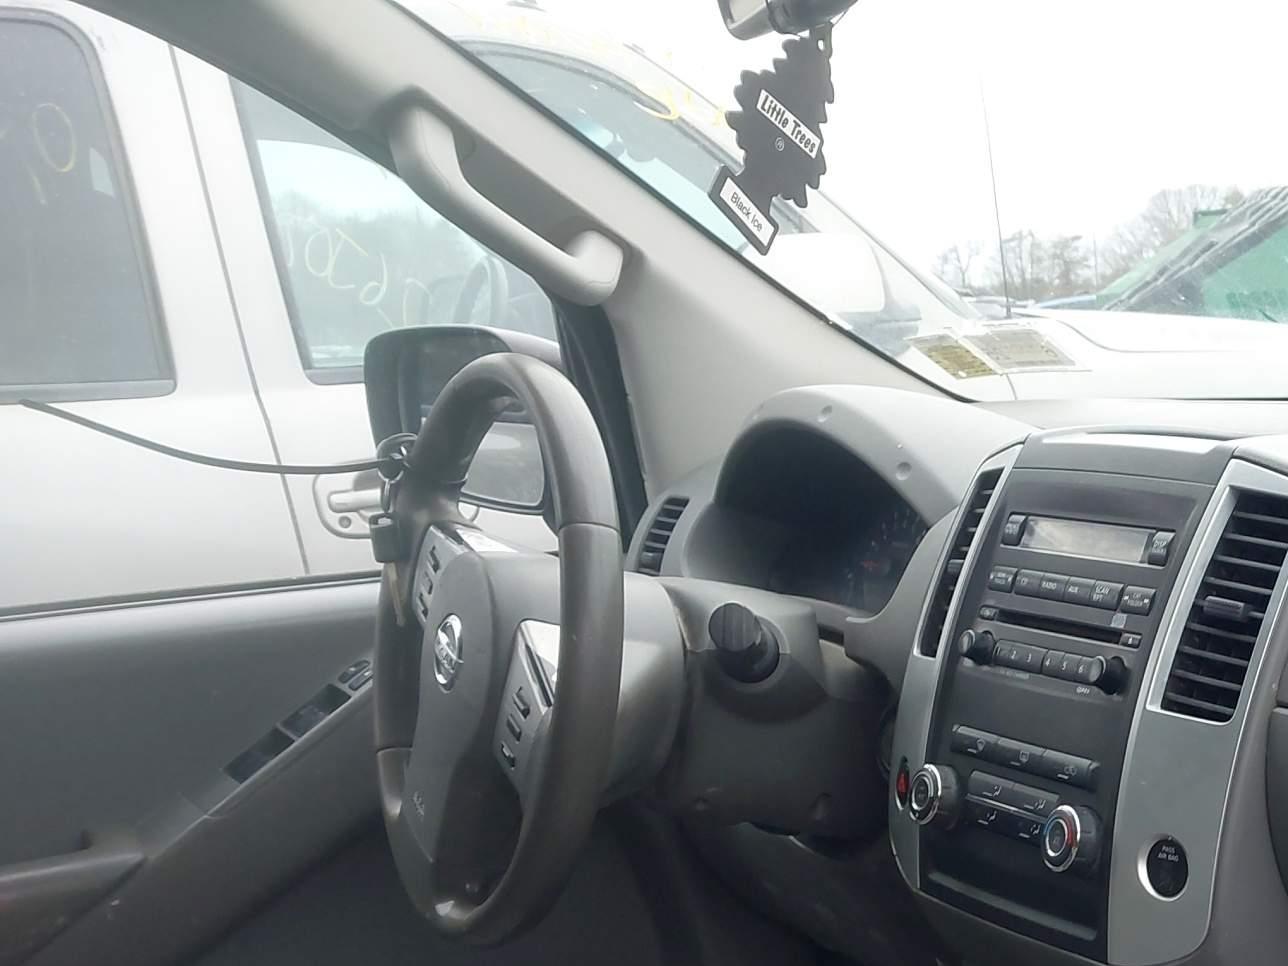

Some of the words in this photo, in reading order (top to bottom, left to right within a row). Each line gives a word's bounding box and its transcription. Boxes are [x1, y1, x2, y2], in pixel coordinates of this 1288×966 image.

[760, 94, 789, 128] Little
[790, 119, 816, 153] Trees
[730, 191, 752, 220] Black
[750, 213, 763, 232] Ice
[1041, 581, 1057, 590] RADIO
[1067, 585, 1079, 593] AUX
[1095, 585, 1111, 595] SCAN
[1011, 650, 1017, 660] 2
[1026, 653, 1032, 663] 3
[1045, 657, 1050, 667] 4
[1061, 661, 1067, 671] 5
[1077, 664, 1084, 674] 6
[1161, 845, 1176, 854] PASS
[1157, 852, 1167, 860] AIR
[1167, 854, 1179, 863] BAG
